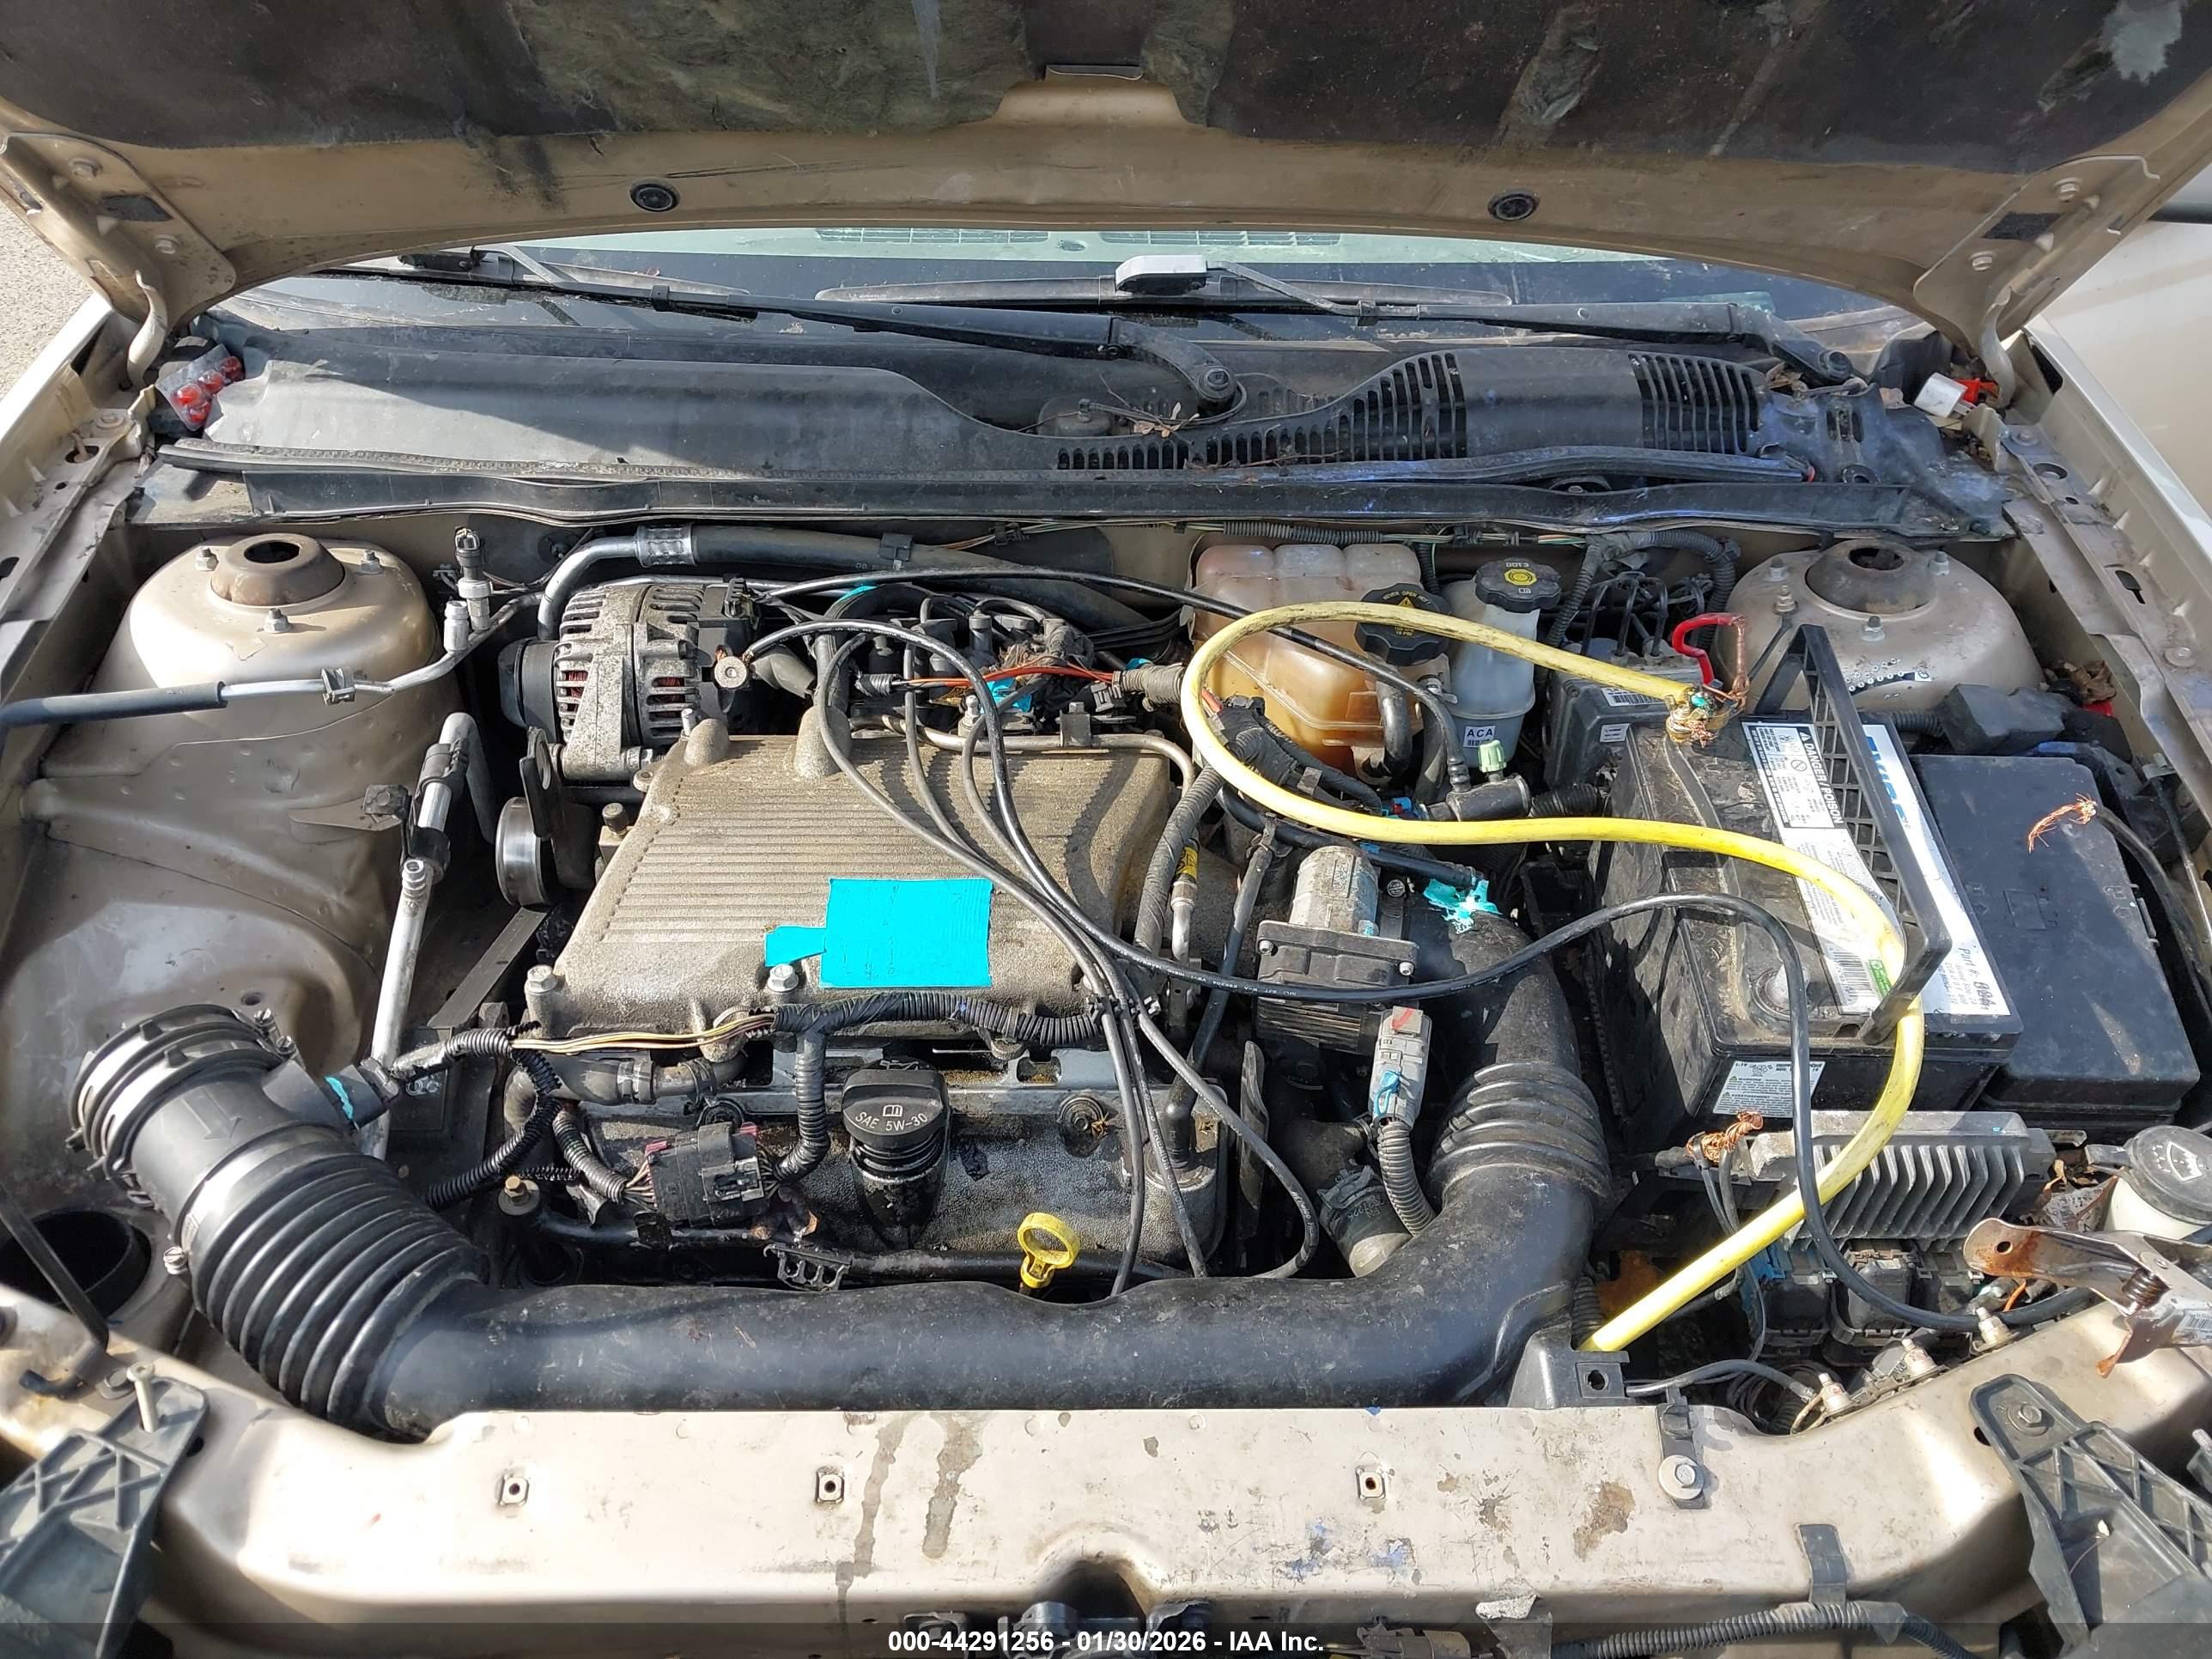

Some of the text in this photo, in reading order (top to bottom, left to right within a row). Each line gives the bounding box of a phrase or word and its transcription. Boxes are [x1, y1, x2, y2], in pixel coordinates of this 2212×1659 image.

[1467, 728, 1493, 738] ACA
[1804, 743, 1827, 781] DANGER
[1822, 787, 1845, 824] POISON
[855, 1111, 928, 1132] SAE 5W-30
[1152, 1128, 1170, 1170] PREMIUM
